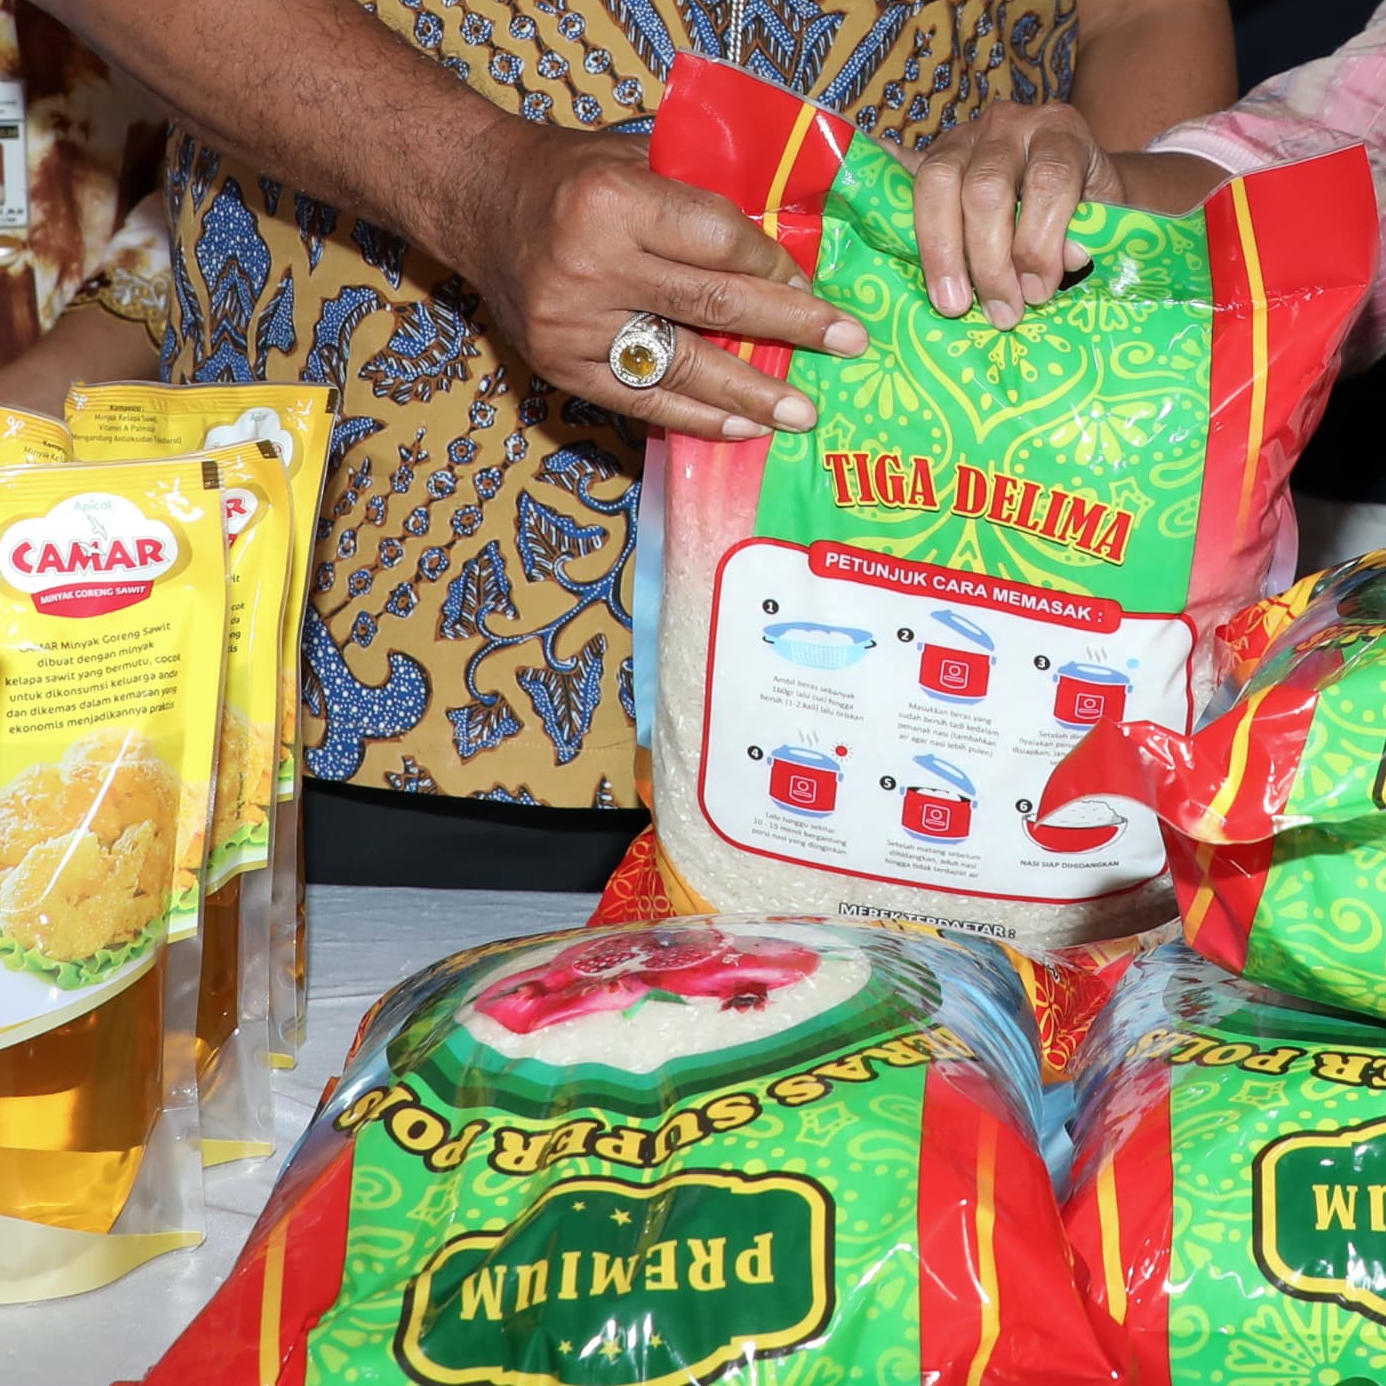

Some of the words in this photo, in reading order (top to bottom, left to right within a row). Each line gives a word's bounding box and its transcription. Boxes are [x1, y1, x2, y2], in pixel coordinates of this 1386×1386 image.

[73, 498, 112, 513] Apical
[825, 452, 939, 511] TIGA
[952, 464, 1133, 565] DELIMA
[11, 538, 166, 575] CAMAR
[40, 592, 75, 605] MINYAK
[75, 588, 114, 599] GORENG
[115, 586, 146, 594] SAWIT
[825, 552, 928, 587] PETUNJUK
[933, 575, 988, 599] CARA
[993, 588, 1091, 621] MEMASAK
[60, 638, 100, 651] Minyak
[102, 629, 141, 644] Goreng
[142, 622, 171, 636] Sawit
[37, 655, 74, 668] dibuat
[77, 651, 116, 664] dengan
[118, 641, 154, 657] minyak
[5, 676, 43, 687] kelapa
[45, 672, 75, 683] sawit
[78, 669, 103, 682] yang
[105, 658, 153, 675] bermutu,
[155, 654, 181, 664] cocok
[9, 692, 43, 702] untuk
[45, 682, 109, 700] dikonsumsi
[111, 673, 156, 689] keluarga
[158, 669, 179, 680] anda
[773, 675, 795, 686] Ambil
[797, 680, 818, 691] beras
[820, 686, 855, 699] sebanyak
[6, 708, 27, 718] dan
[30, 702, 76, 717] dikemas
[79, 697, 111, 710] dalam
[113, 688, 159, 702] kemasan
[161, 685, 177, 697] yang
[760, 694, 783, 704] bersih
[796, 691, 810, 699] lalu
[828, 698, 853, 710] hingga
[9, 721, 64, 734] ekonomis
[66, 706, 148, 727] menjadikannya
[149, 701, 175, 714] praktis
[898, 712, 921, 721] sudah
[923, 717, 947, 727] bersih
[909, 703, 948, 715] Masukkan
[950, 710, 971, 720] beras
[973, 716, 991, 725] yang
[898, 722, 931, 734] penanak
[933, 730, 949, 738] nasi
[1039, 730, 1068, 739] Setelah
[765, 812, 781, 820] Lalu
[782, 816, 808, 828] tunggu
[810, 823, 835, 833] sekitar
[751, 828, 770, 837] porsi
[788, 838, 806, 847] yang
[780, 825, 802, 835] menit
[804, 831, 846, 847] bergantung
[886, 839, 914, 849] Setelah
[917, 846, 946, 856] matang
[948, 851, 981, 860] sebelum
[885, 858, 910, 867] hingga
[913, 863, 931, 871] tidak
[933, 866, 966, 877] terdapat
[1061, 861, 1119, 869] DIHIDANGKAN
[486, 1086, 761, 1174] SUPER
[458, 1231, 775, 1322] PREMIUM
